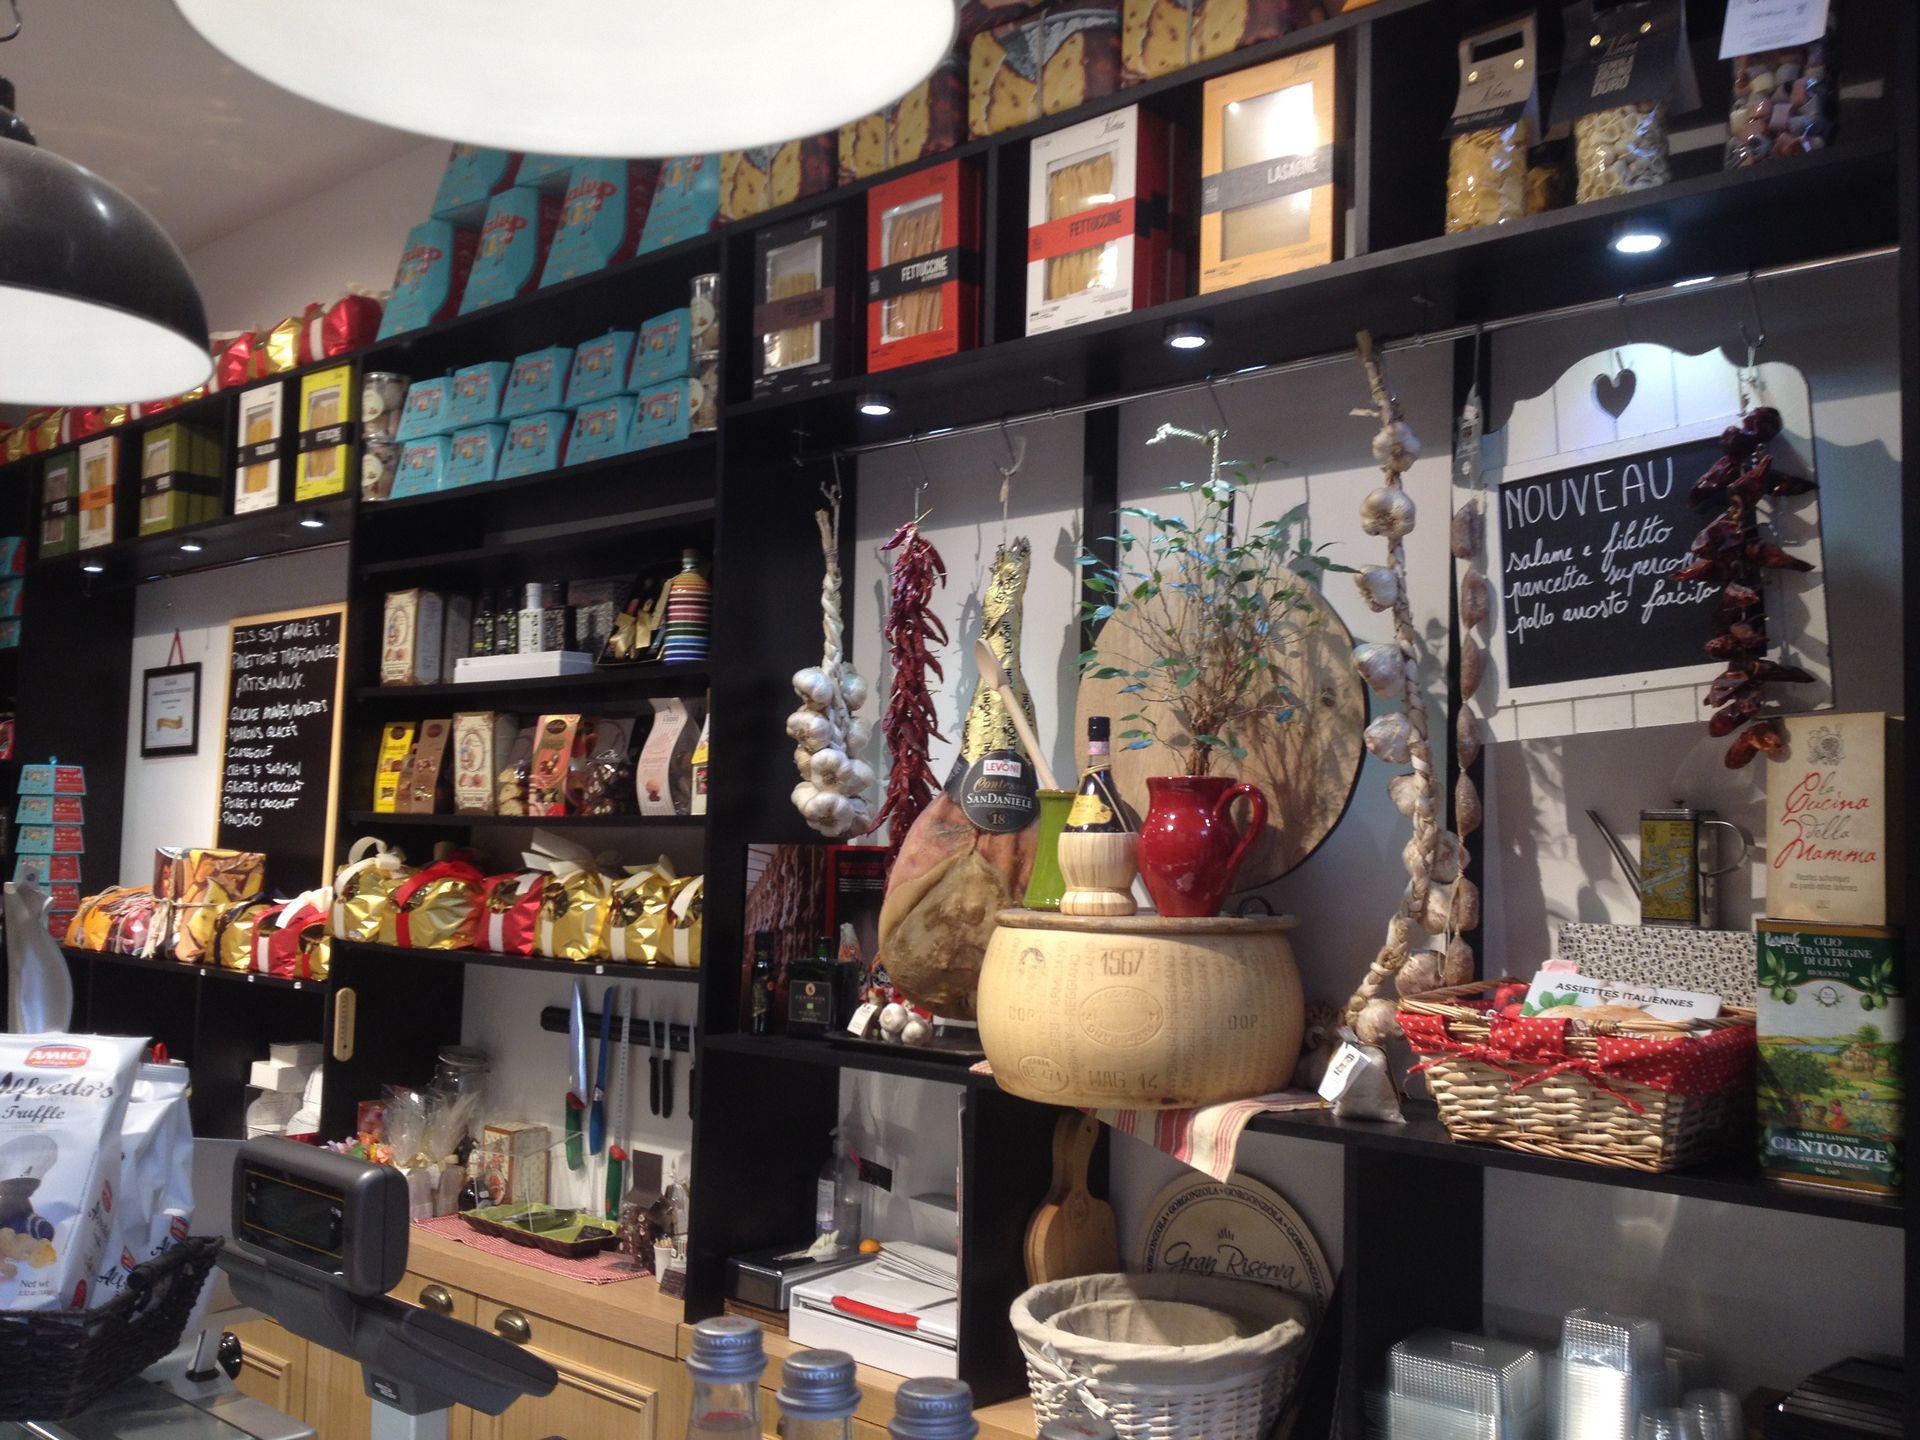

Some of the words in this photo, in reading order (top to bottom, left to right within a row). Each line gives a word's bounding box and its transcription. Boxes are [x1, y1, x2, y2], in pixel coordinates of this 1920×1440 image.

[1268, 156, 1318, 184] LASAGNE
[1070, 208, 1122, 237] FETTUCCINE
[901, 255, 948, 281] FETTUCCINE
[1505, 457, 1673, 529] NOUVEAU
[1505, 538, 1573, 573] salame
[1582, 545, 1592, 556] e
[1601, 515, 1673, 573] filetto
[1505, 565, 1594, 614] pancetta
[1508, 603, 1555, 644] pollo
[1641, 579, 1722, 624] farcito
[1003, 621, 1013, 653] LEVONI
[980, 693, 990, 727] LEVONI
[1007, 716, 1016, 750] LEVONI
[985, 763, 1020, 773] LEVONI
[1781, 772, 1870, 822] Cucina
[1818, 771, 1836, 795] la
[992, 814, 1006, 824] 18
[1800, 814, 1850, 840] della
[1774, 819, 1877, 869] Mamma
[1785, 945, 1821, 956] EXTRA
[1824, 947, 1872, 960] VERGINE
[1814, 937, 1842, 948] OLIO
[1804, 956, 1815, 966] DI
[1817, 957, 1853, 968] OLIVA
[1555, 982, 1619, 999] ASSIETTES
[1622, 991, 1694, 1008] ITALIENNES
[28, 1050, 88, 1061] AMICA
[2, 1105, 65, 1122] Truffle
[1770, 1135, 1888, 1163] CENTONZE
[1168, 1186, 1219, 1215] GORGONZOLA
[1224, 1186, 1284, 1226] GORGONZOLA
[1147, 1216, 1168, 1272] ORGONZOLA
[1164, 1241, 1218, 1274] Gran
[1217, 1244, 1302, 1289] Riserva
[1286, 1225, 1324, 1298] GORGONZOLA
